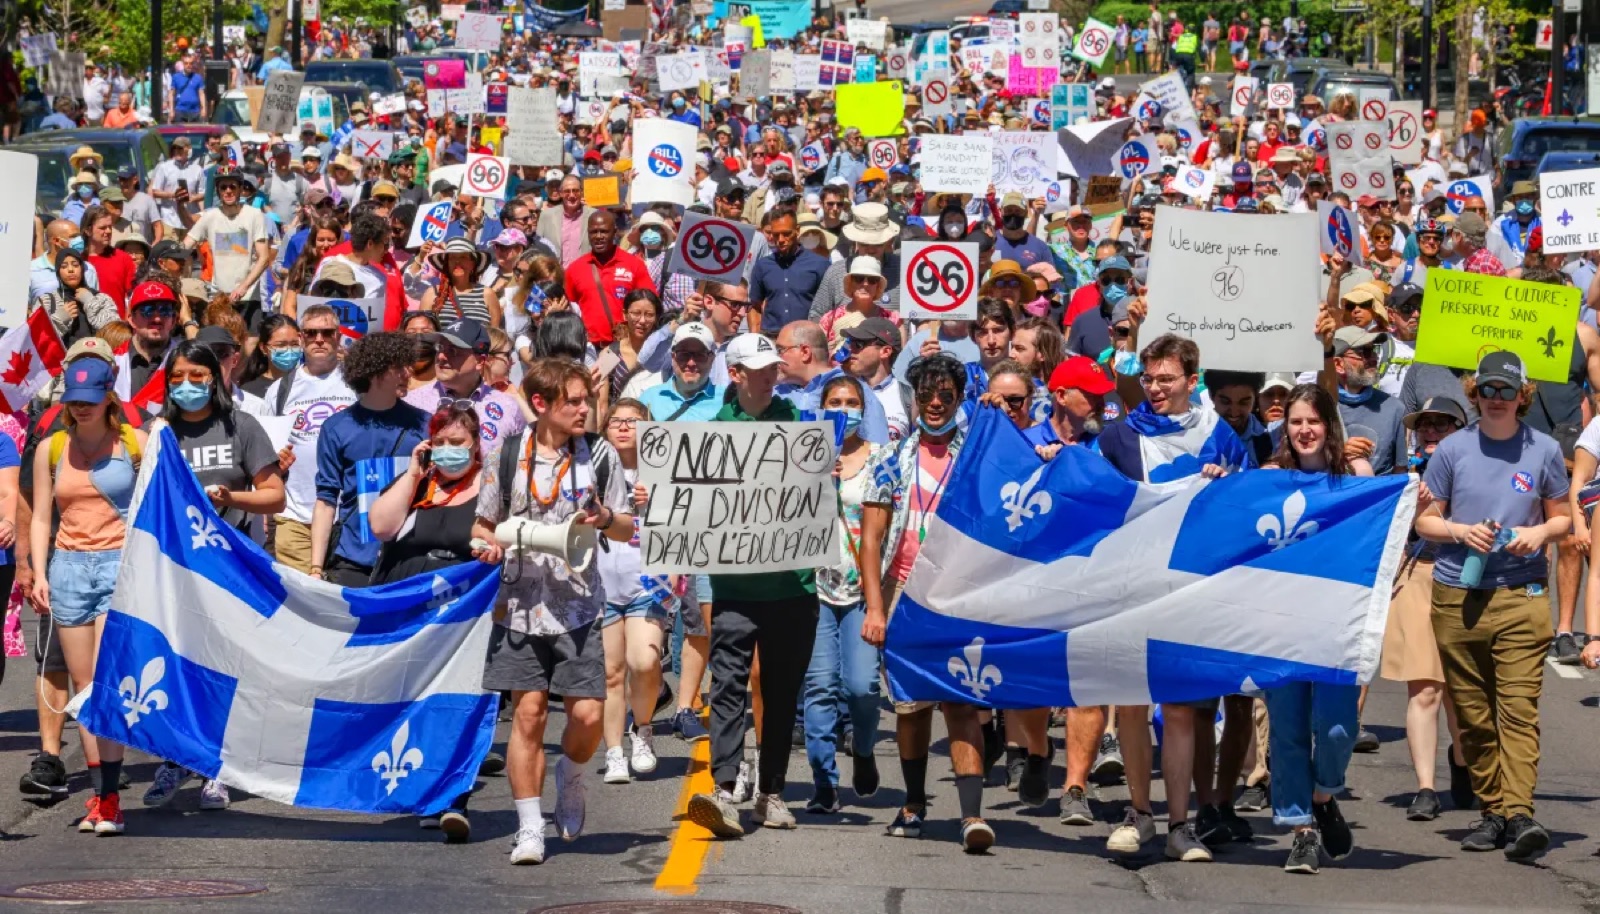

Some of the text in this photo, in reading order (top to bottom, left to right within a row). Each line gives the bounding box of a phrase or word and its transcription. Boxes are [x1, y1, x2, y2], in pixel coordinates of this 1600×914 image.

[1084, 34, 1105, 51] 96
[969, 61, 984, 73] 96
[1273, 89, 1290, 100] 96
[655, 148, 679, 160] BILL
[875, 147, 893, 163] 96
[473, 164, 500, 185] 96
[655, 159, 677, 175] 96
[1455, 184, 1473, 195] PL
[1547, 182, 1595, 199] CONTRE
[433, 206, 449, 219] PL
[690, 231, 738, 264] 96
[1169, 226, 1280, 265] We were just fine.
[1547, 233, 1599, 246] CONTRE LE
[916, 261, 964, 296] 96
[1214, 271, 1239, 297] 96
[1434, 277, 1568, 307] VOTRE CULTURE:
[1440, 300, 1538, 323] PRÉSERVEZ SANS
[1166, 313, 1295, 341] Stop dividing Quebecers.
[1472, 324, 1523, 341] OPPRIMER
[180, 443, 232, 467] IFE
[641, 430, 667, 459] 96
[673, 424, 788, 482] NON À
[799, 430, 826, 462] 96
[643, 482, 822, 529] LA DIVISION
[646, 531, 717, 567] DANS
